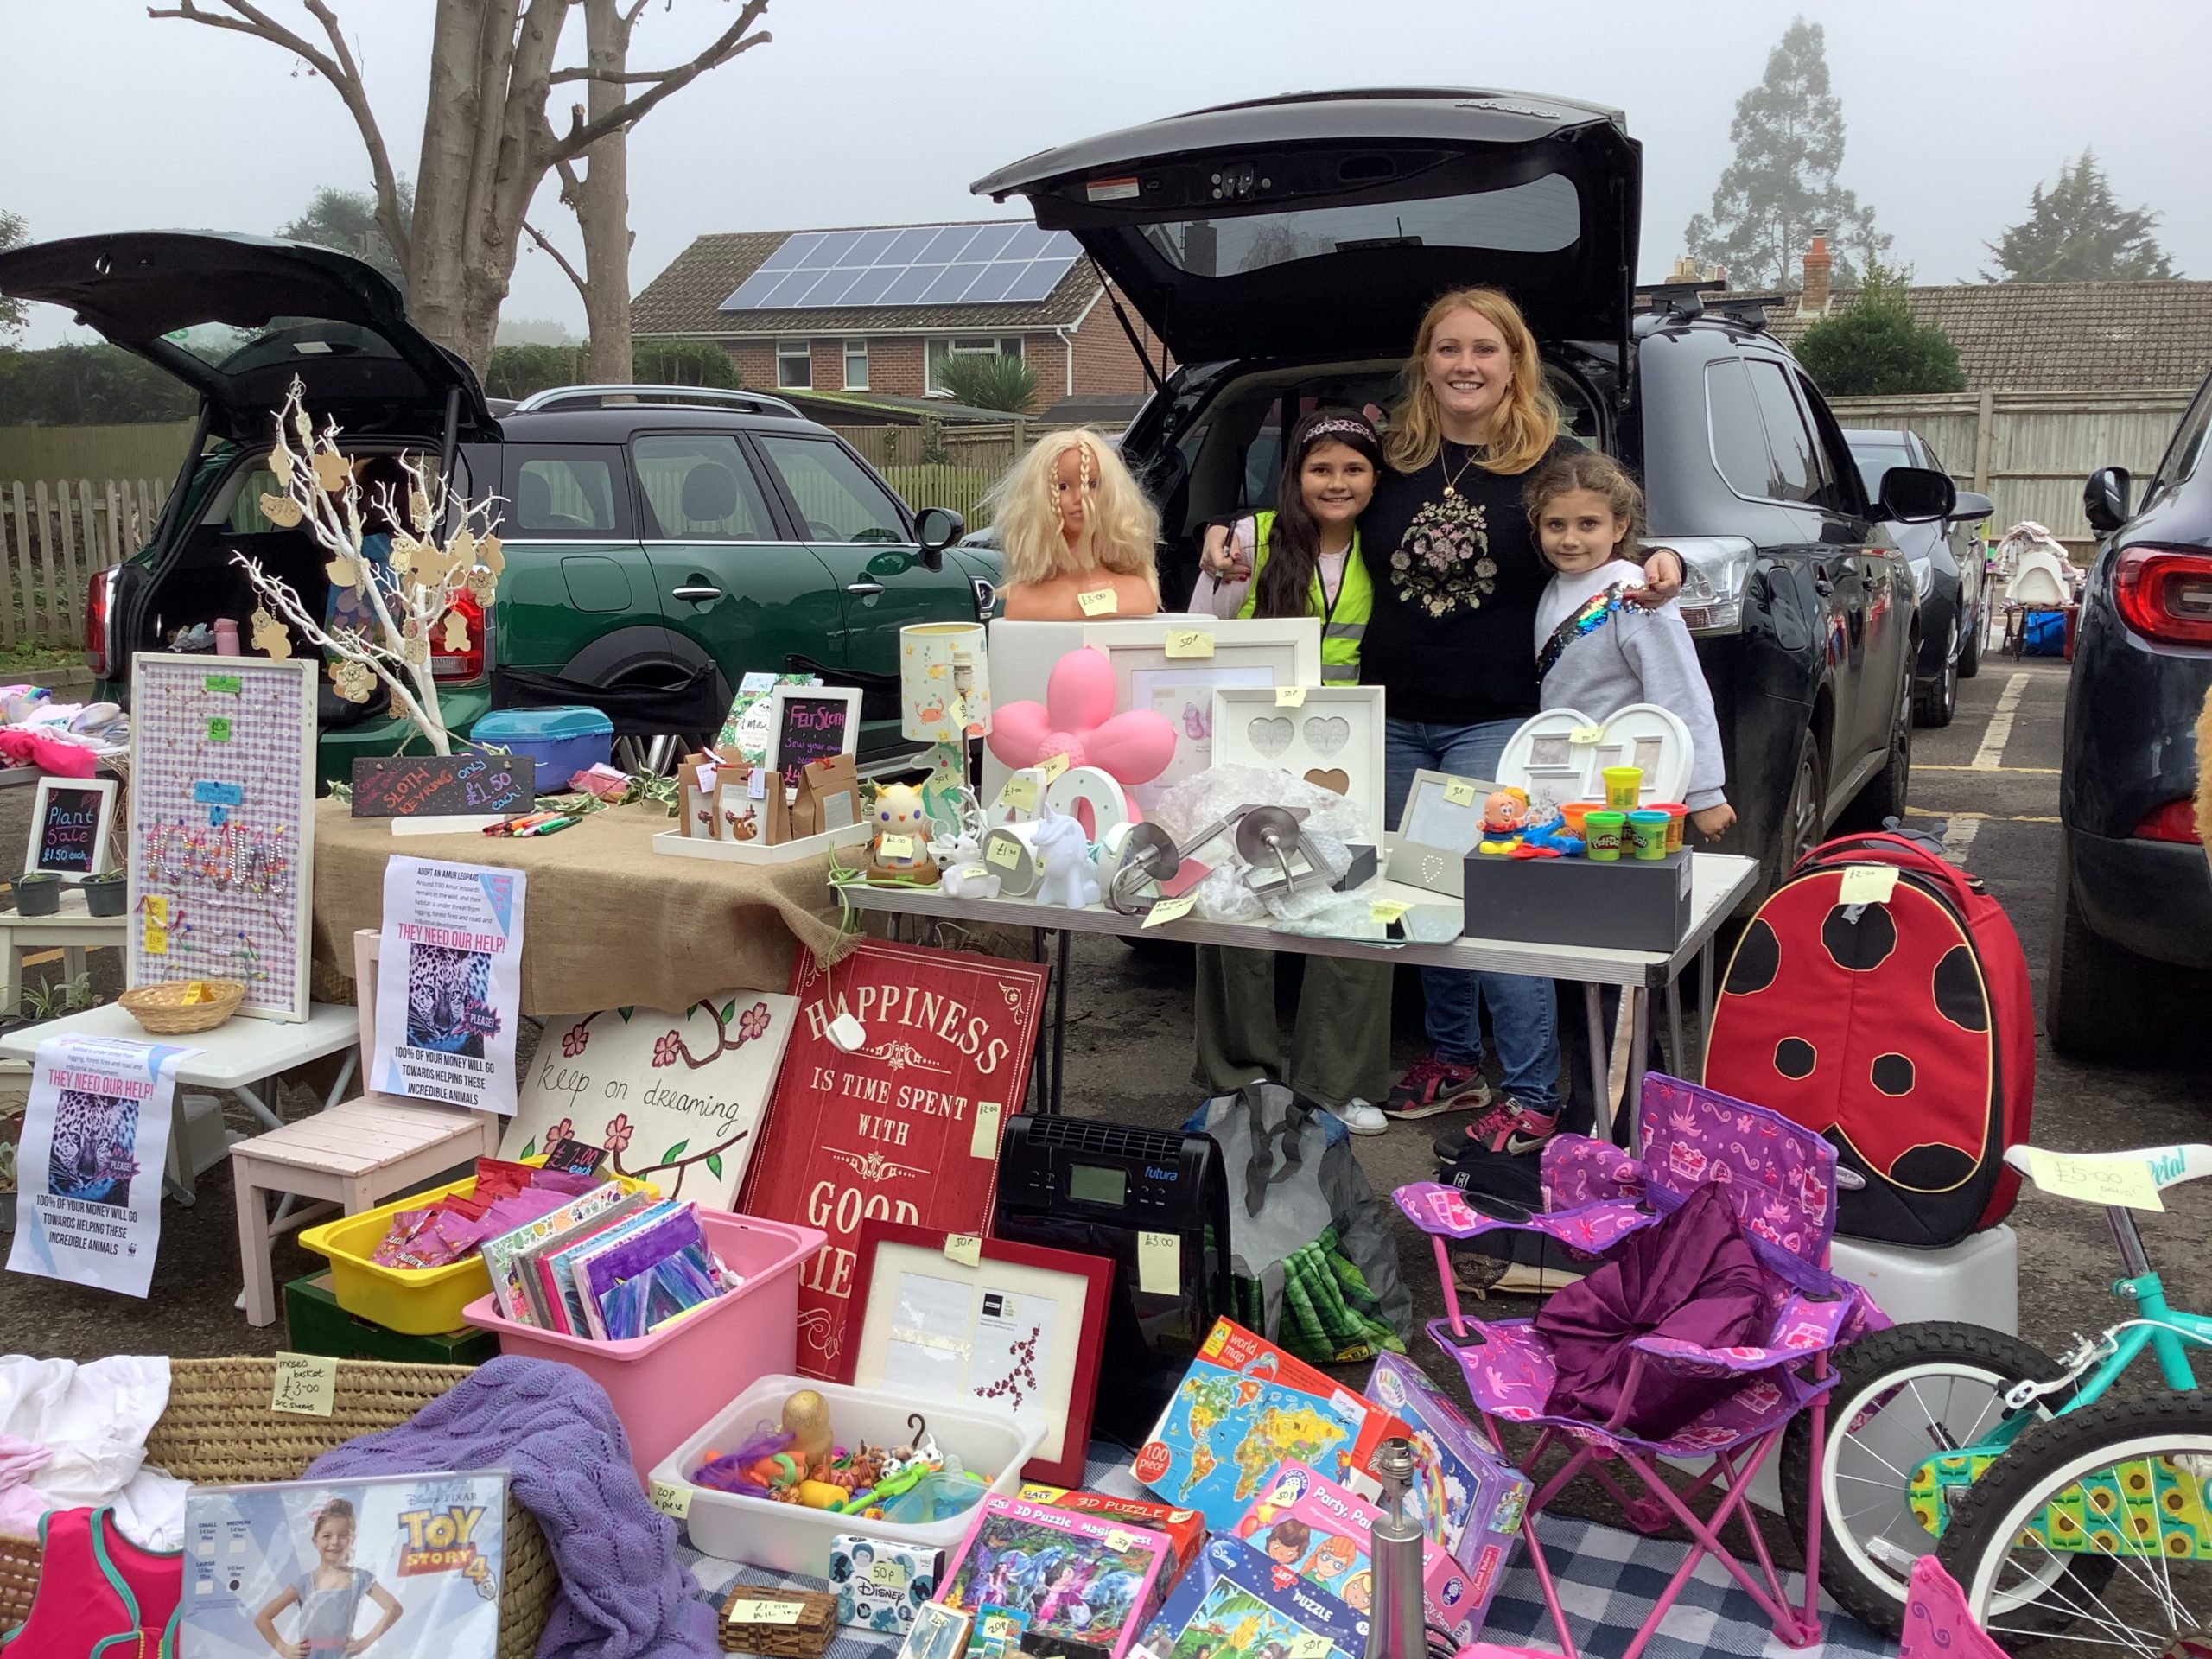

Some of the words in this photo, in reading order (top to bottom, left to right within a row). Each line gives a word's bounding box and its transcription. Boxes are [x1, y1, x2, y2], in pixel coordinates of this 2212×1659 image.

[383, 766, 430, 809] SLOTH
[466, 772, 512, 807] £1.50
[48, 806, 93, 825] Plant
[47, 830, 88, 845] Sale
[42, 847, 67, 862] £1.50
[417, 867, 433, 875] ADOPT
[442, 870, 457, 880] AMUR
[457, 872, 479, 881] LEOPARD
[416, 880, 434, 888] Around
[459, 885, 480, 893] leopards
[397, 923, 423, 941] THEY
[424, 926, 449, 945] NEED
[452, 931, 471, 949] OUR
[475, 934, 505, 953] HELP!
[470, 1013, 495, 1028] PLEASE!
[804, 985, 1009, 1075] HAPPINESS
[395, 1046, 415, 1059] 100%
[416, 1050, 424, 1061] OF
[425, 1051, 442, 1065] YOUR
[443, 1053, 467, 1069] MONEY
[467, 1059, 484, 1072] WILL
[486, 1062, 494, 1073] GO
[48, 1069, 73, 1088] THEY
[75, 1073, 100, 1092] NEED
[103, 1077, 122, 1096] OUR
[125, 1081, 154, 1100] HELP!
[402, 1065, 435, 1080] TOWARDS
[435, 1070, 463, 1085] HELPING
[464, 1075, 486, 1090] THESE
[537, 1052, 589, 1107] keep
[605, 1081, 628, 1100] on
[408, 1083, 447, 1099] INCREDIBLE
[449, 1090, 479, 1105] ANIMALS
[810, 1066, 835, 1092] IS
[842, 1073, 892, 1104] TIME
[896, 1085, 968, 1121] SPENT
[858, 1112, 910, 1146] WITH
[110, 1160, 133, 1173] PLEASE!
[569, 1164, 593, 1177] each
[1144, 1166, 1179, 1182] futura
[2146, 1147, 2186, 1186] Petal
[36, 1194, 55, 1208] 100%
[57, 1198, 66, 1209] OF
[67, 1199, 85, 1213] YOUR
[86, 1203, 110, 1217] MONEY
[111, 1207, 127, 1221] WILL
[129, 1211, 138, 1223] GO
[808, 1181, 919, 1234] GOOD
[43, 1212, 75, 1230] TOWARDS
[76, 1219, 105, 1235] HELPING
[105, 1224, 128, 1239] THESE
[49, 1231, 87, 1249] INCREDIBLE
[87, 1239, 118, 1255] ANIMALS
[1224, 1345, 1245, 1365] map
[1230, 1333, 1259, 1356] world
[1145, 1445, 1168, 1460] 100
[1138, 1458, 1165, 1472] piece
[1284, 1470, 1308, 1490] ORCHARD
[444, 1492, 478, 1503] PIXAR
[989, 1498, 1008, 1509] GALT
[1024, 1490, 1051, 1500] GALT
[1313, 1485, 1349, 1519] Party,
[1014, 1504, 1032, 1517] 3D
[1031, 1508, 1072, 1528] Puzzle
[1077, 1497, 1101, 1508] 3D
[1104, 1499, 1165, 1518] PUZZLE
[398, 1505, 487, 1554] TOY
[406, 1549, 472, 1567] STORY
[1211, 1543, 1238, 1571] Disney
[462, 1555, 488, 1585] 4
[1276, 1569, 1294, 1582] 187
[1293, 1591, 1334, 1623] PUZZLE
